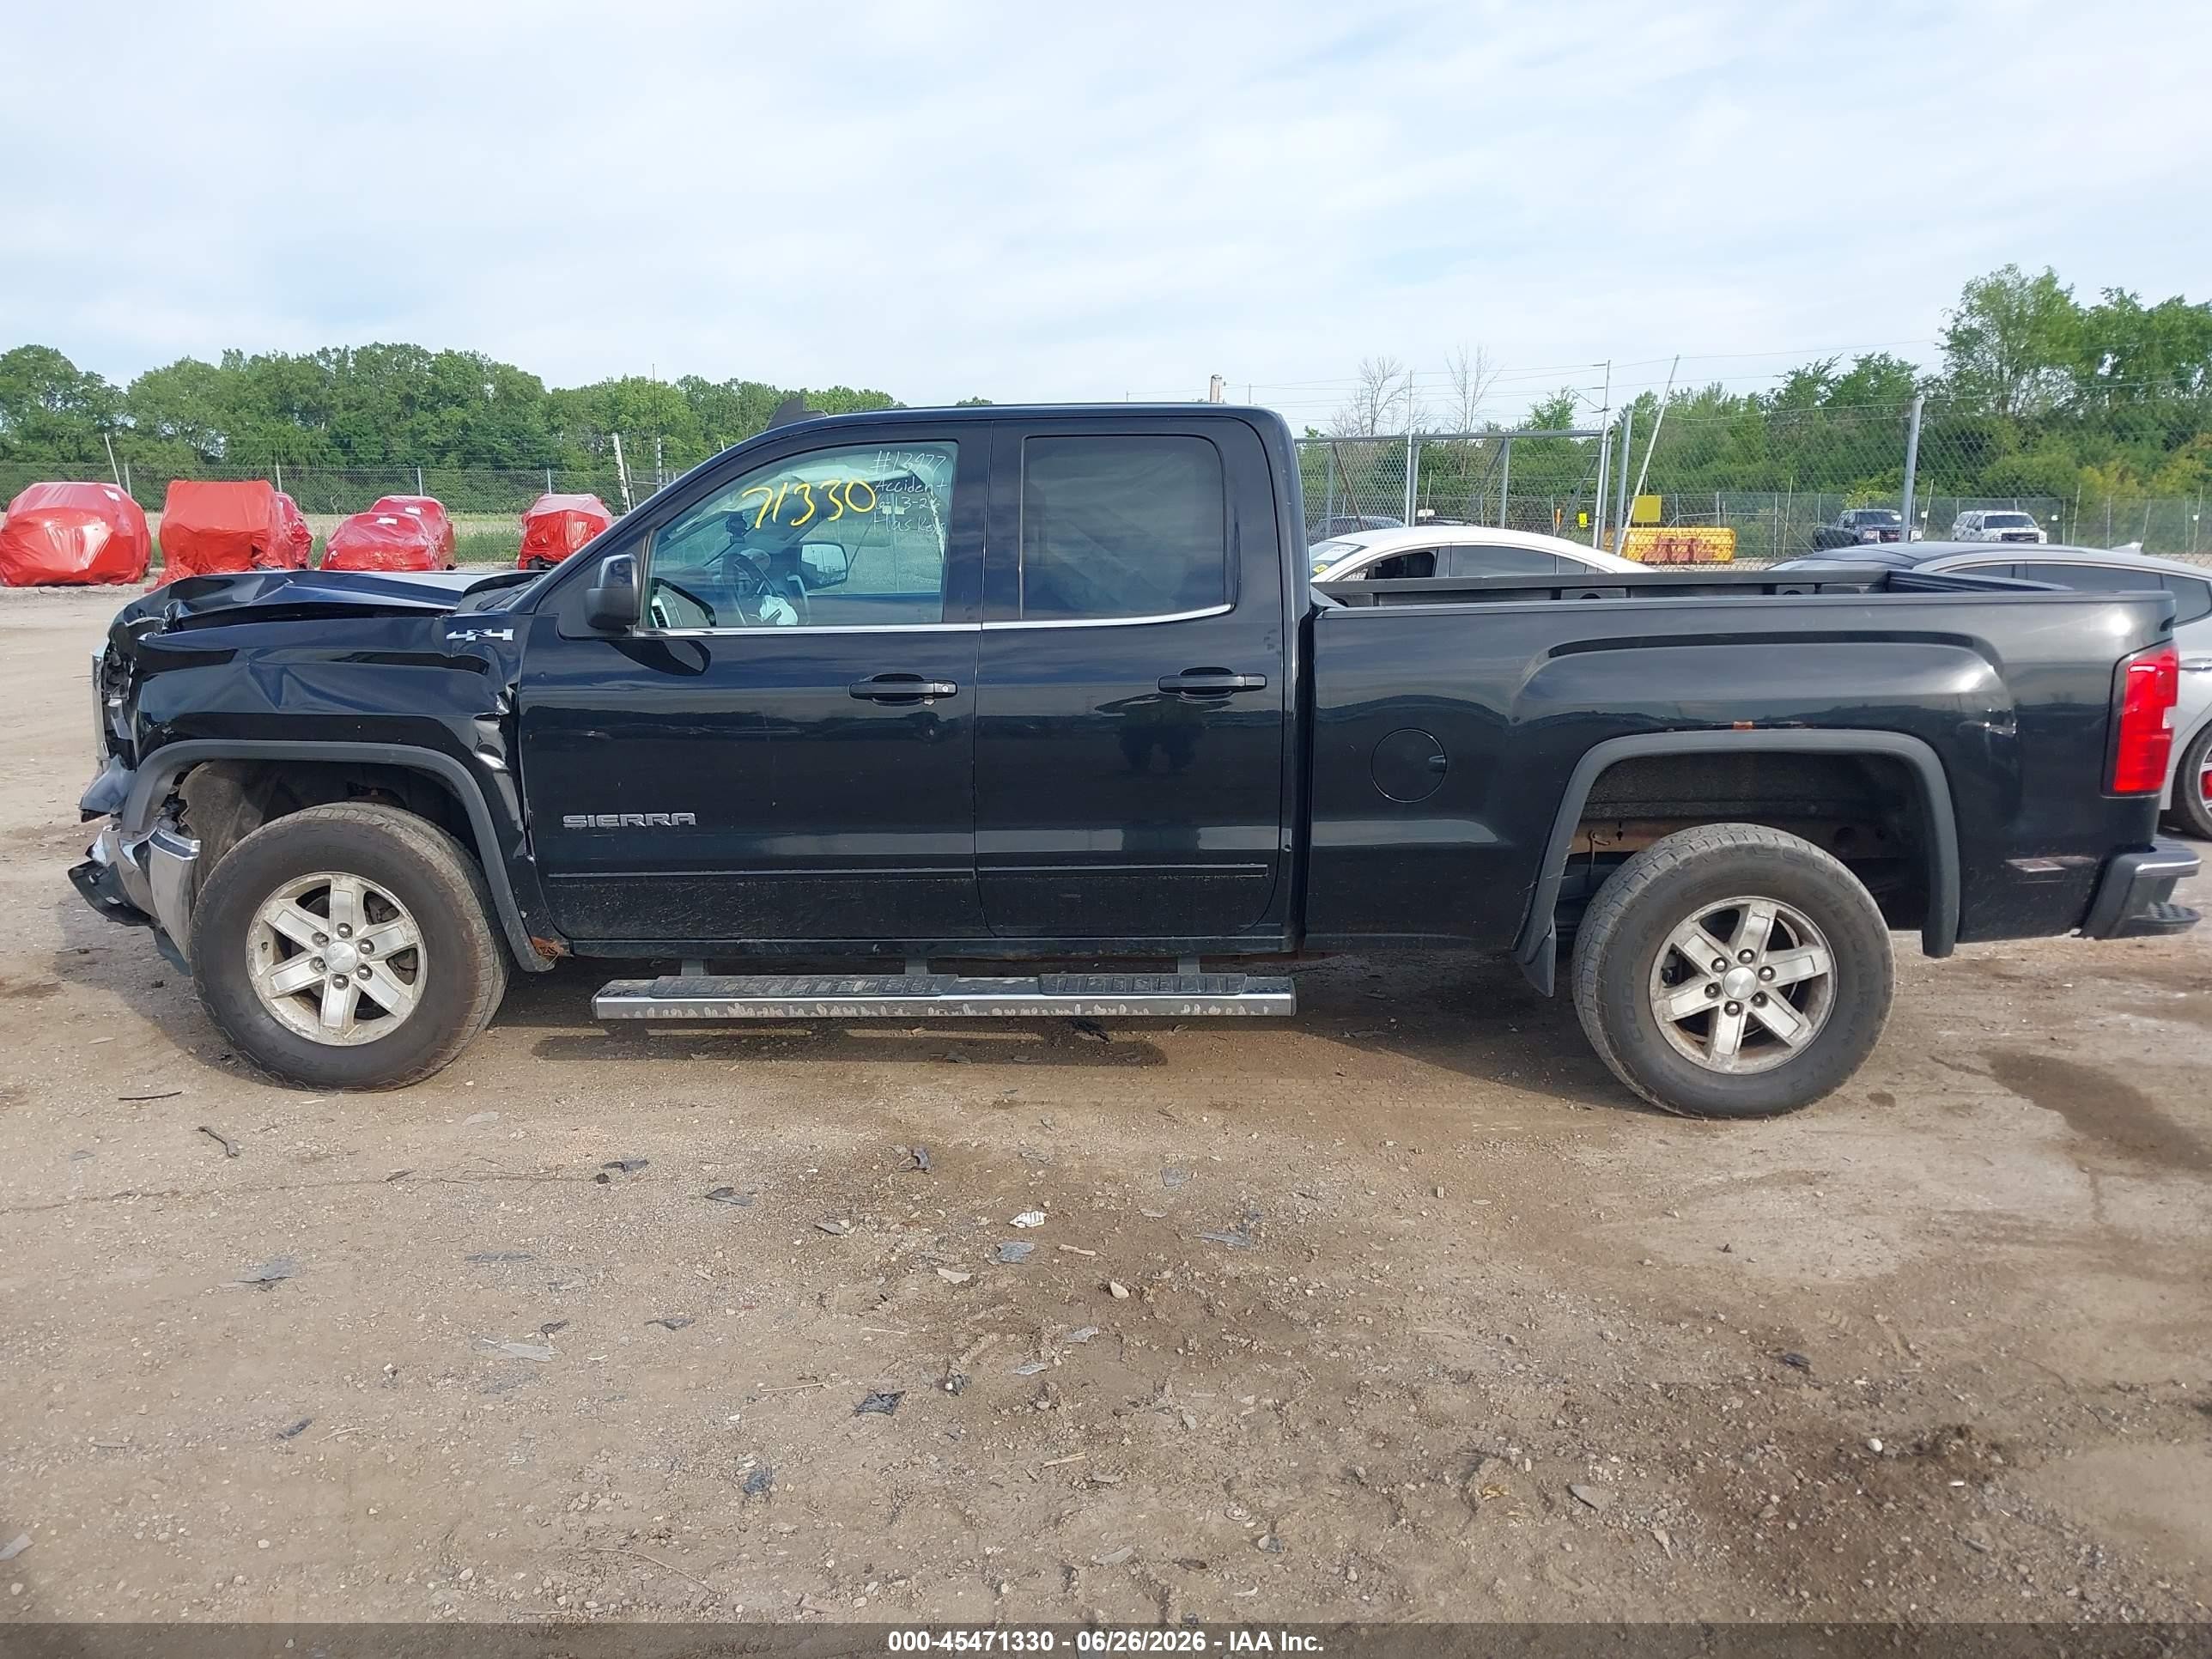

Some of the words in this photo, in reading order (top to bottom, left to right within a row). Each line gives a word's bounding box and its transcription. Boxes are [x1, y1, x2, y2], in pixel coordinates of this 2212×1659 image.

[873, 475, 948, 494] Accident
[741, 479, 876, 530] 71330
[873, 511, 912, 532] Has
[562, 812, 696, 828] SIERRA
